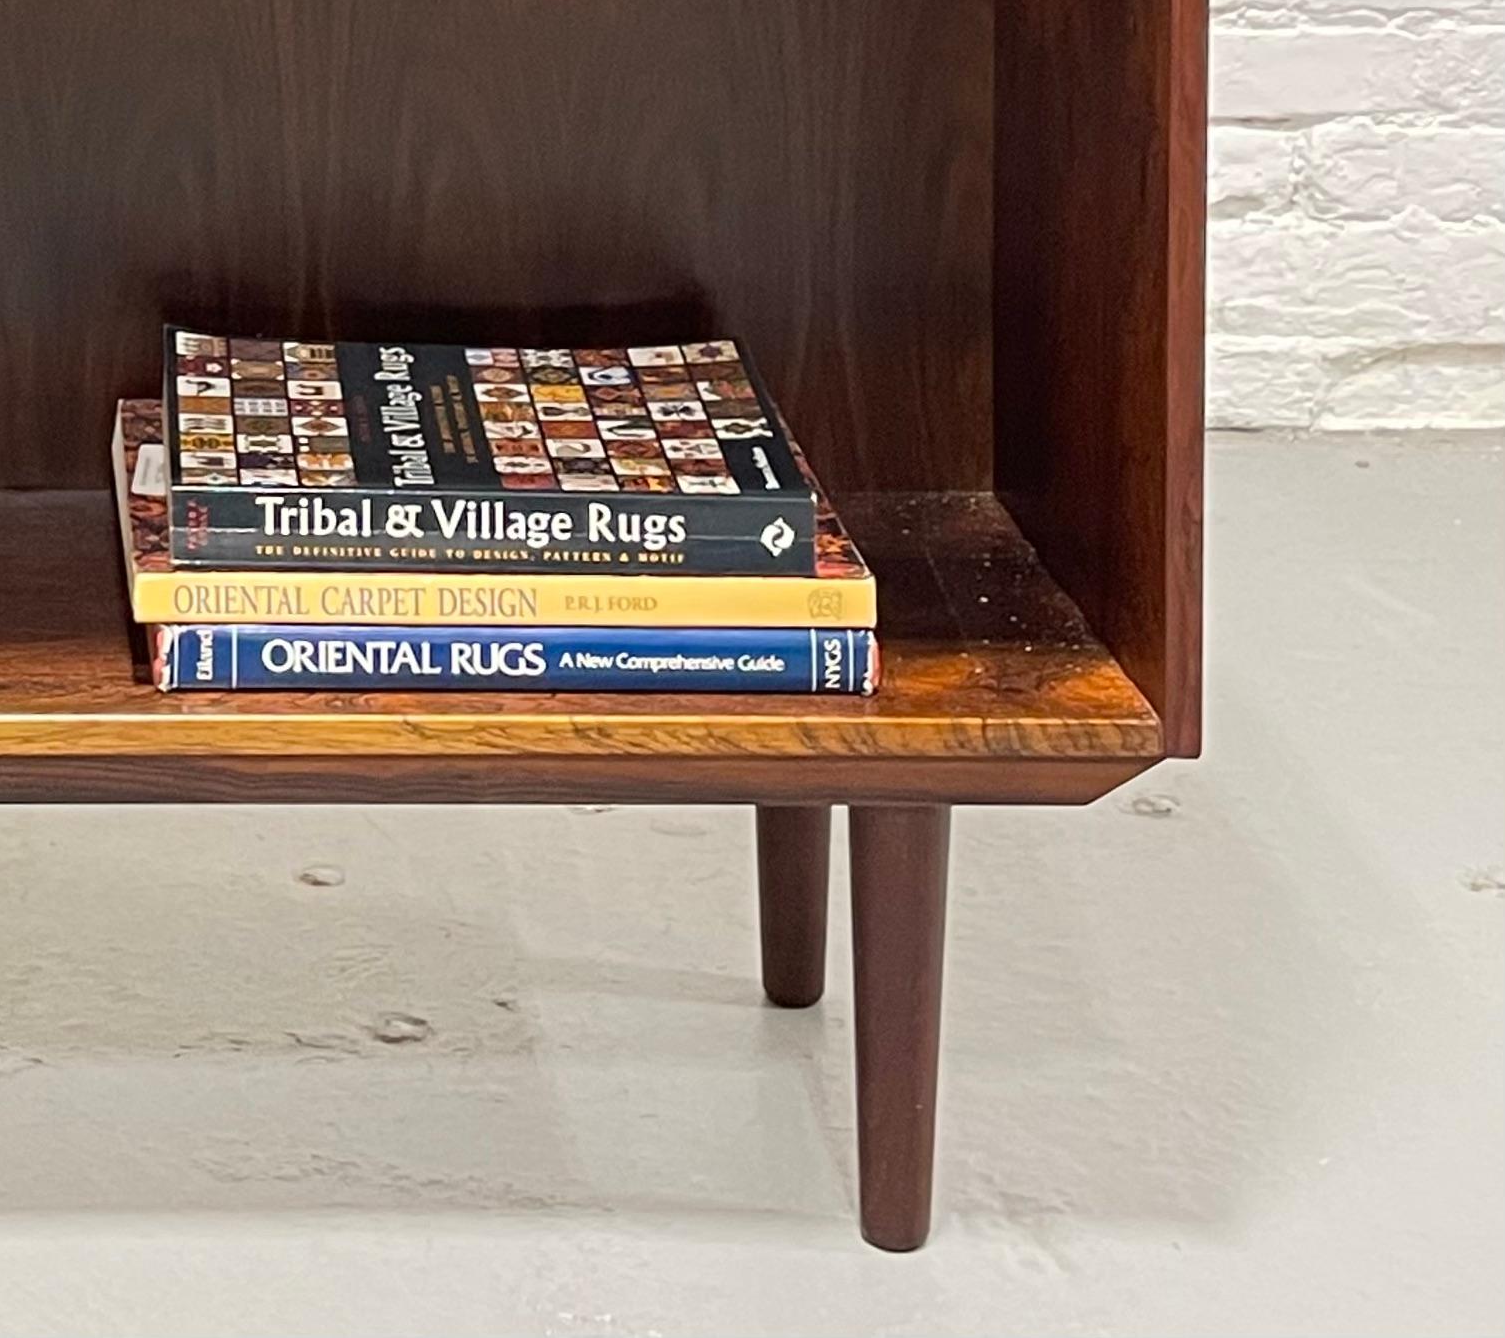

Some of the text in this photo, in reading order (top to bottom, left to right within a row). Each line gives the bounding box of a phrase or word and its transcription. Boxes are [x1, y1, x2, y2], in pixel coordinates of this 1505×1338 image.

[374, 346, 415, 381] Rugs
[380, 384, 423, 432] Village
[389, 449, 435, 487] Tribal
[255, 496, 372, 537] Tribal
[385, 504, 425, 539] &
[431, 499, 573, 548] Village
[588, 502, 687, 551] Rugs
[255, 544, 284, 556] THE
[293, 546, 382, 557] DEFINITIVE
[390, 547, 437, 558] GUIDE
[446, 548, 465, 559] TO
[543, 551, 611, 562] PATTERN
[638, 553, 685, 563] MOTIF
[175, 585, 537, 617] ORIENTAL CARPET DESIGN
[608, 596, 658, 611] FORD
[261, 638, 546, 676] ORIENTAL RUGS
[559, 652, 785, 673] A New Comprehensive Guide
[824, 638, 842, 689] NYGS
